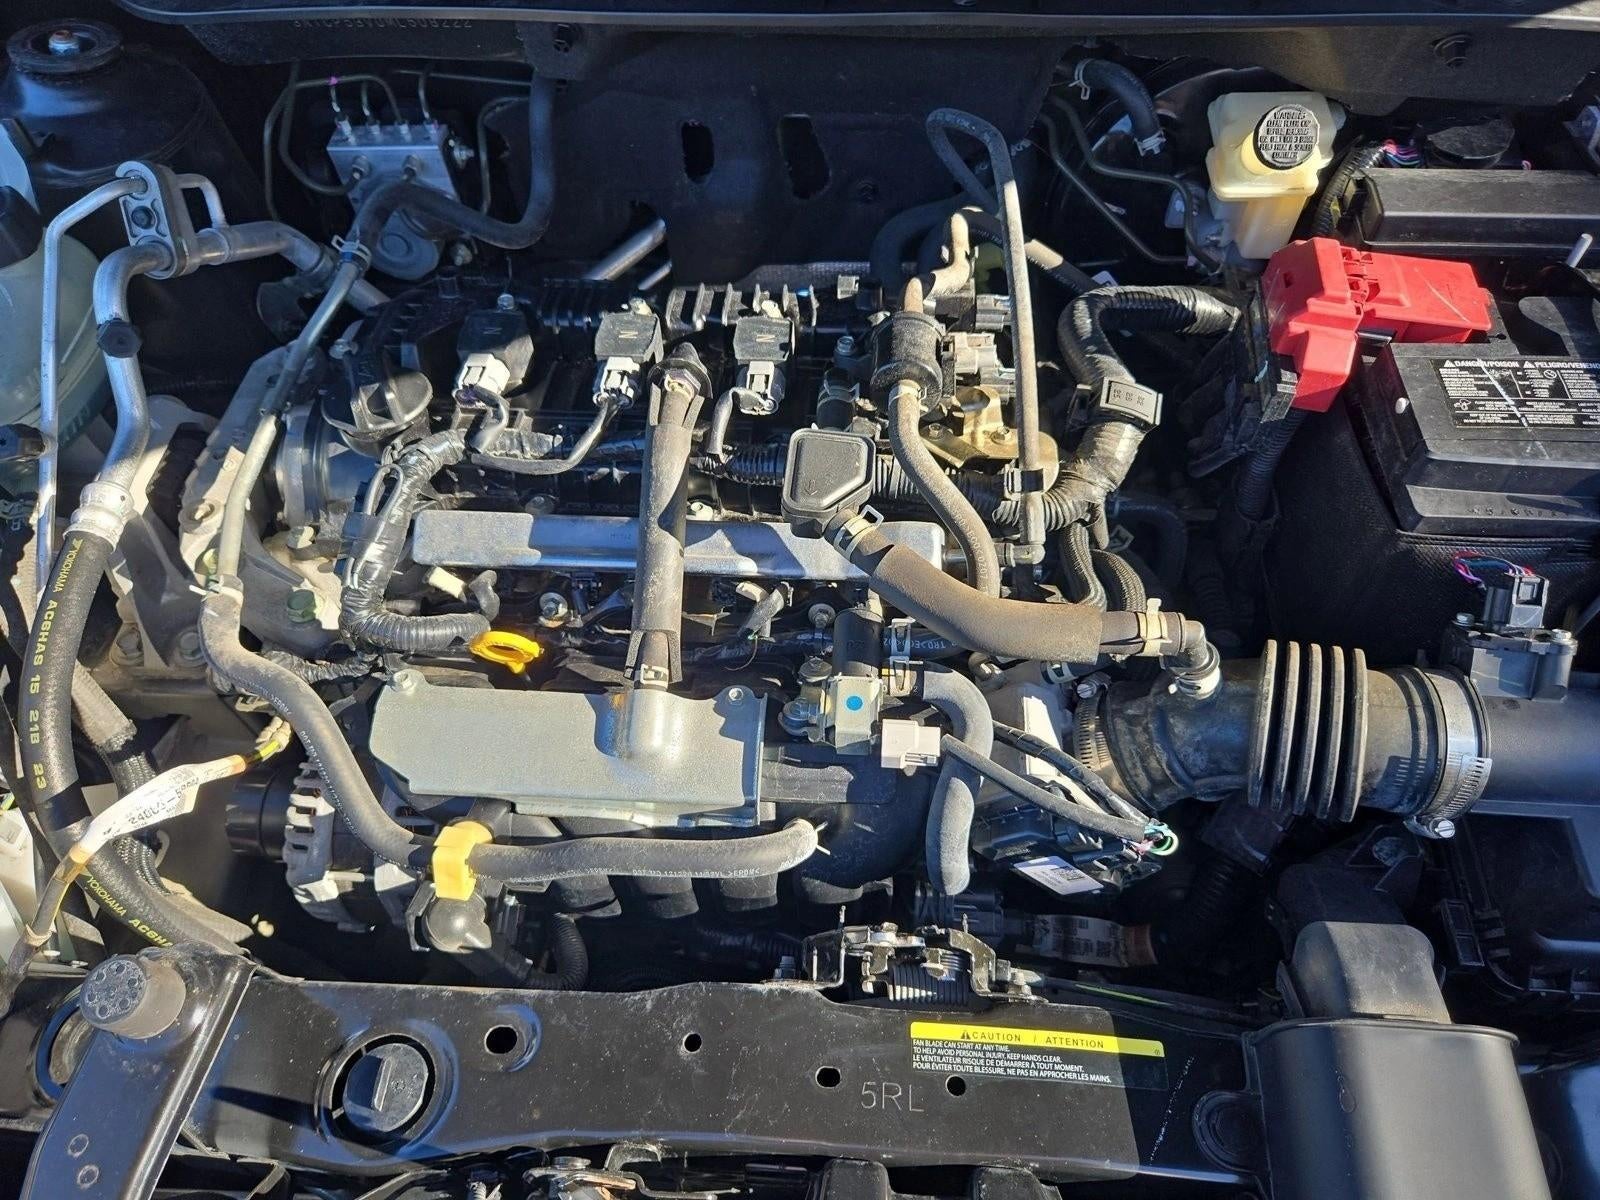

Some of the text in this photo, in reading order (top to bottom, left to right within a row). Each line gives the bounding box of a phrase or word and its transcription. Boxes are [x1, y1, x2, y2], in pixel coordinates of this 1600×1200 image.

[53, 550, 78, 592] YOKOHAMA
[30, 674, 40, 694] 15
[33, 763, 47, 789] 23
[87, 876, 127, 916] YOKOHAMA
[972, 1032, 1021, 1042] CAUTION
[1046, 1036, 1104, 1048] ATTENTION
[995, 1044, 1010, 1052] TIME.
[921, 1055, 961, 1063] VENTILATEUR
[962, 1057, 984, 1066] RISQUE
[986, 1058, 994, 1066] DE
[1054, 1064, 1084, 1072] MOMENT.
[922, 1047, 936, 1055] HELP
[937, 1048, 954, 1056] AVOID
[956, 1050, 984, 1058] PERSONAL
[1022, 1054, 1041, 1062] HANDS
[1043, 1055, 1062, 1063] CLEAR.
[932, 1062, 952, 1071] ÉVITER
[1040, 1070, 1078, 1080] APPROCHER
[861, 1082, 924, 1111] 5RL
